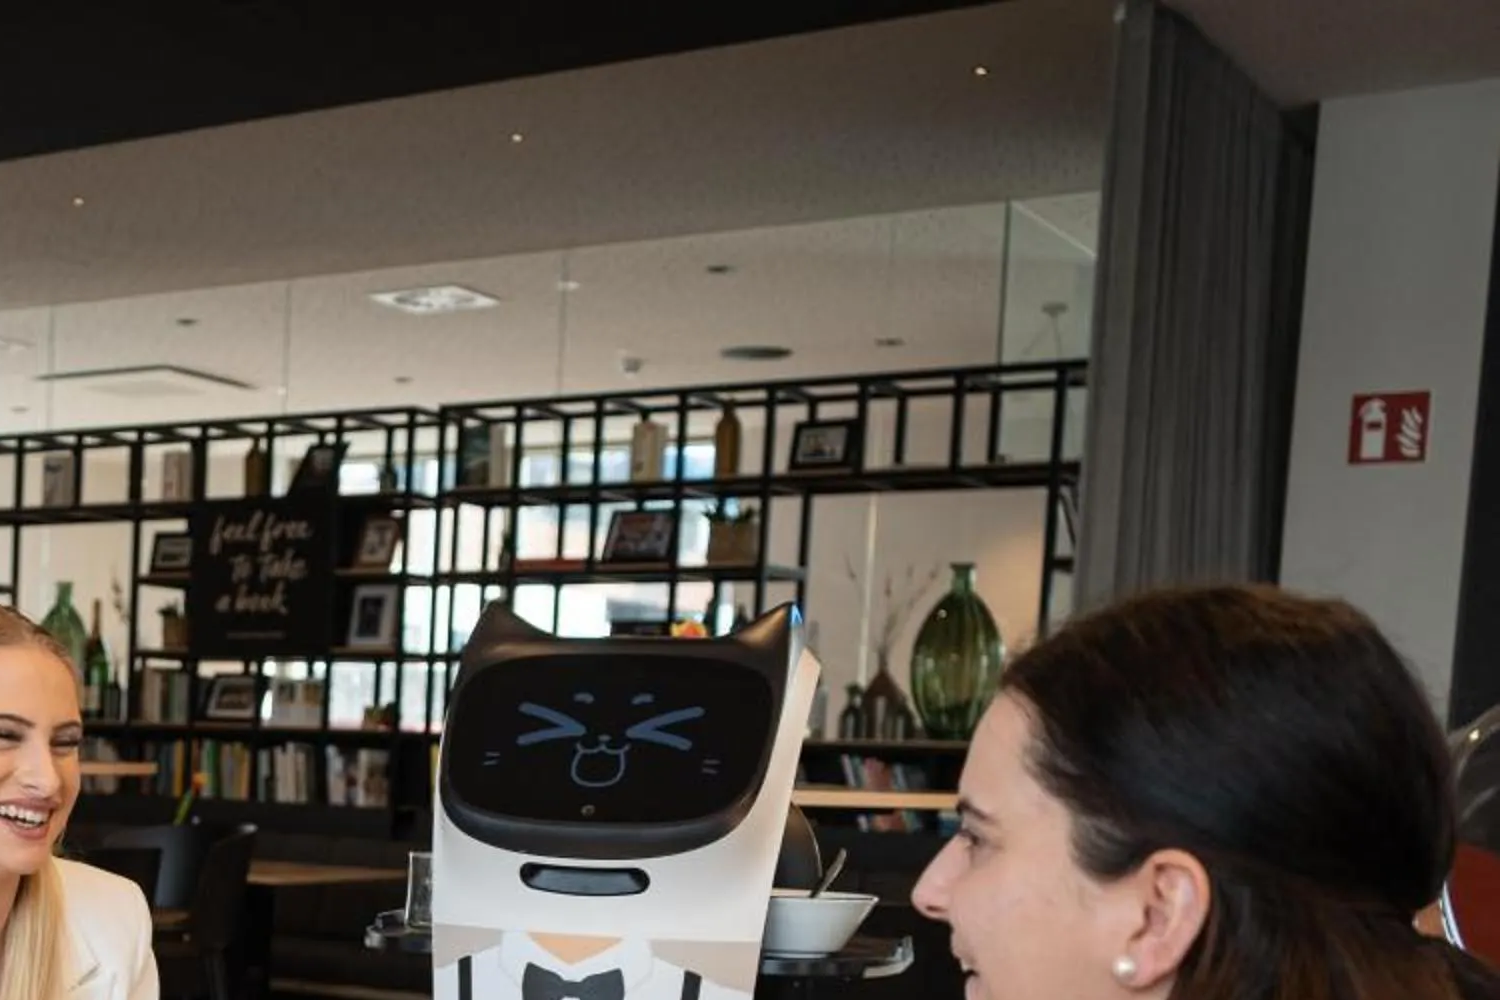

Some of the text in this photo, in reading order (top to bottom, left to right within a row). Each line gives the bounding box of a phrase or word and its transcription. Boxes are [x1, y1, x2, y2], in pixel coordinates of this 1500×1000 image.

[209, 510, 312, 556] feel free
[214, 581, 288, 615] a book
